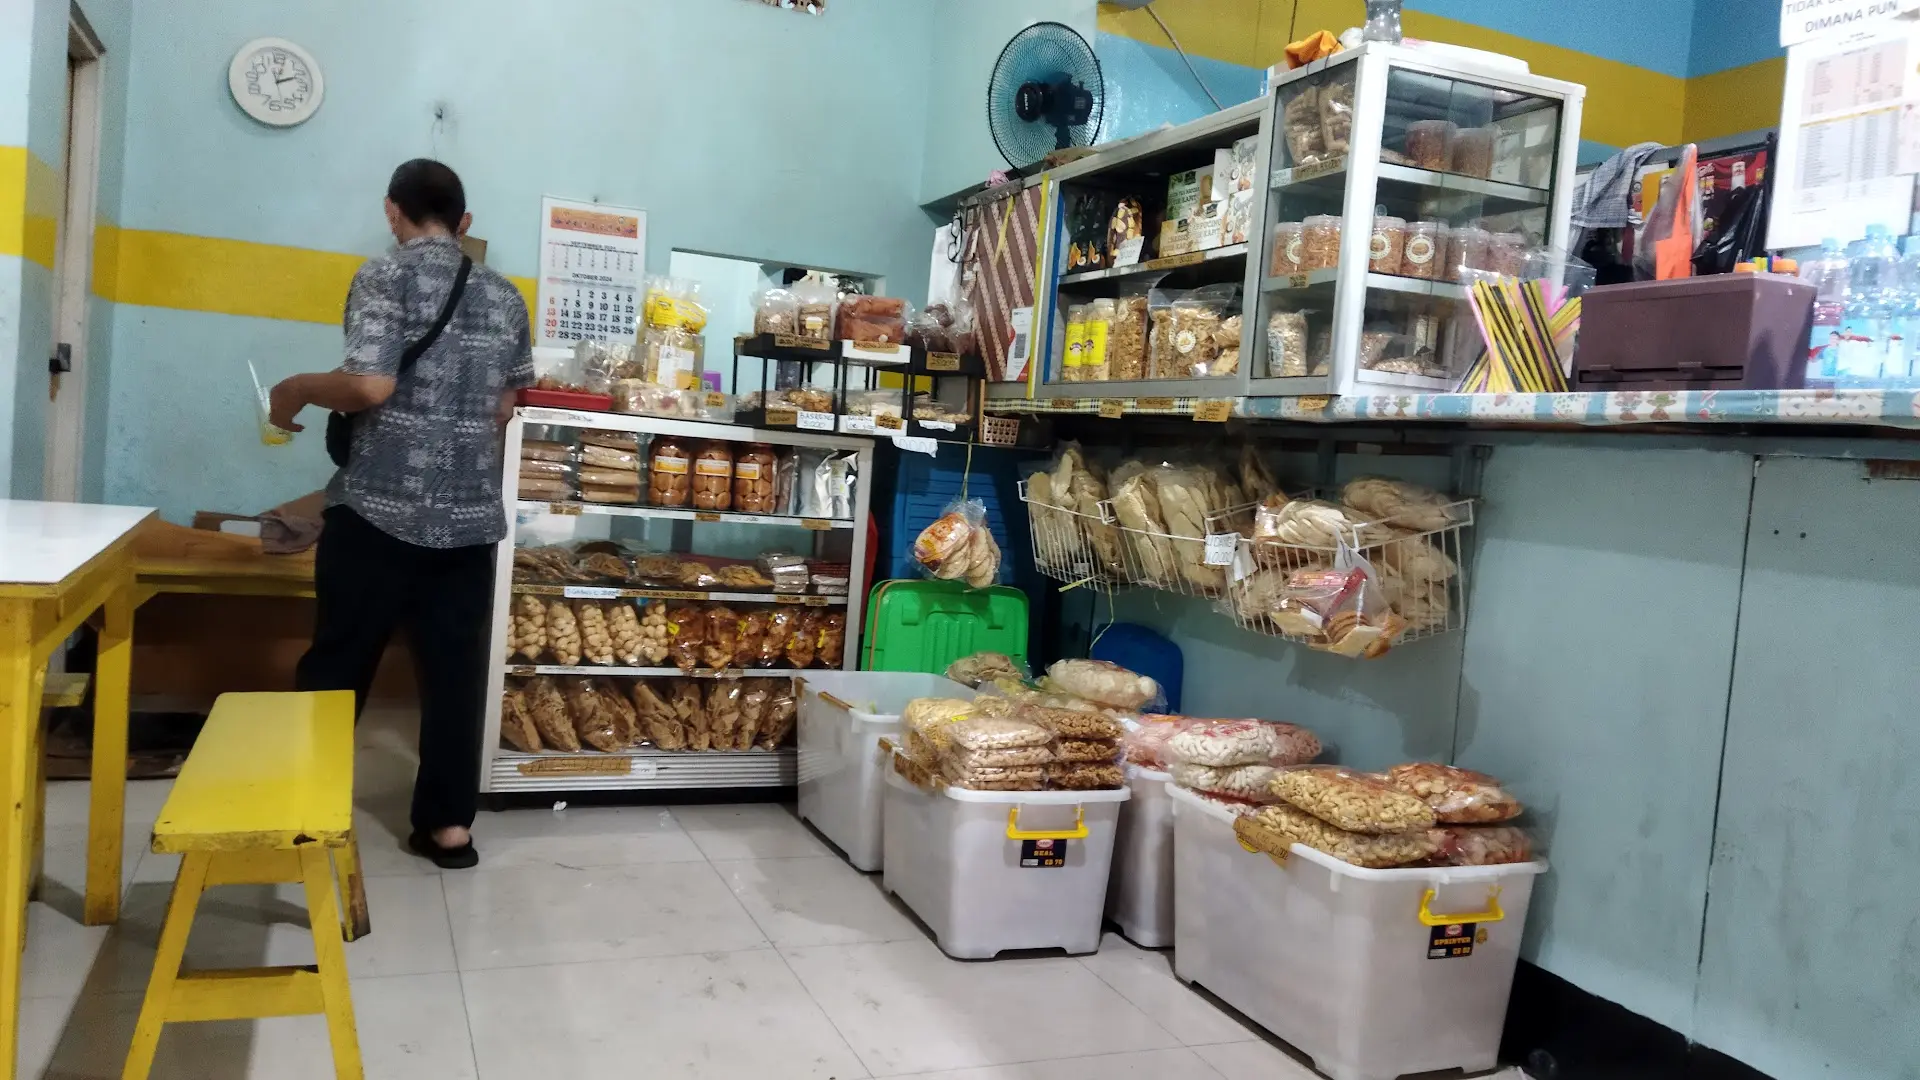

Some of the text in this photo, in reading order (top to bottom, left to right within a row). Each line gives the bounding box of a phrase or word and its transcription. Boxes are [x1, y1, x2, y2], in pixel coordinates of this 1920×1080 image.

[1805, 1, 1898, 33] DIMANA PUN
[572, 272, 598, 280] OKTOBER
[576, 289, 633, 303] 1 2 3 4 5
[549, 297, 634, 314] 6 7 8 9 10 11 12
[547, 307, 633, 325] 13 14 15 16 17 18 19
[545, 319, 634, 335] 20 21 22 23 24 25 26
[545, 329, 556, 338] 27
[558, 331, 569, 339] 28
[570, 332, 582, 340] 29
[1434, 937, 1471, 946] SPRINTER
